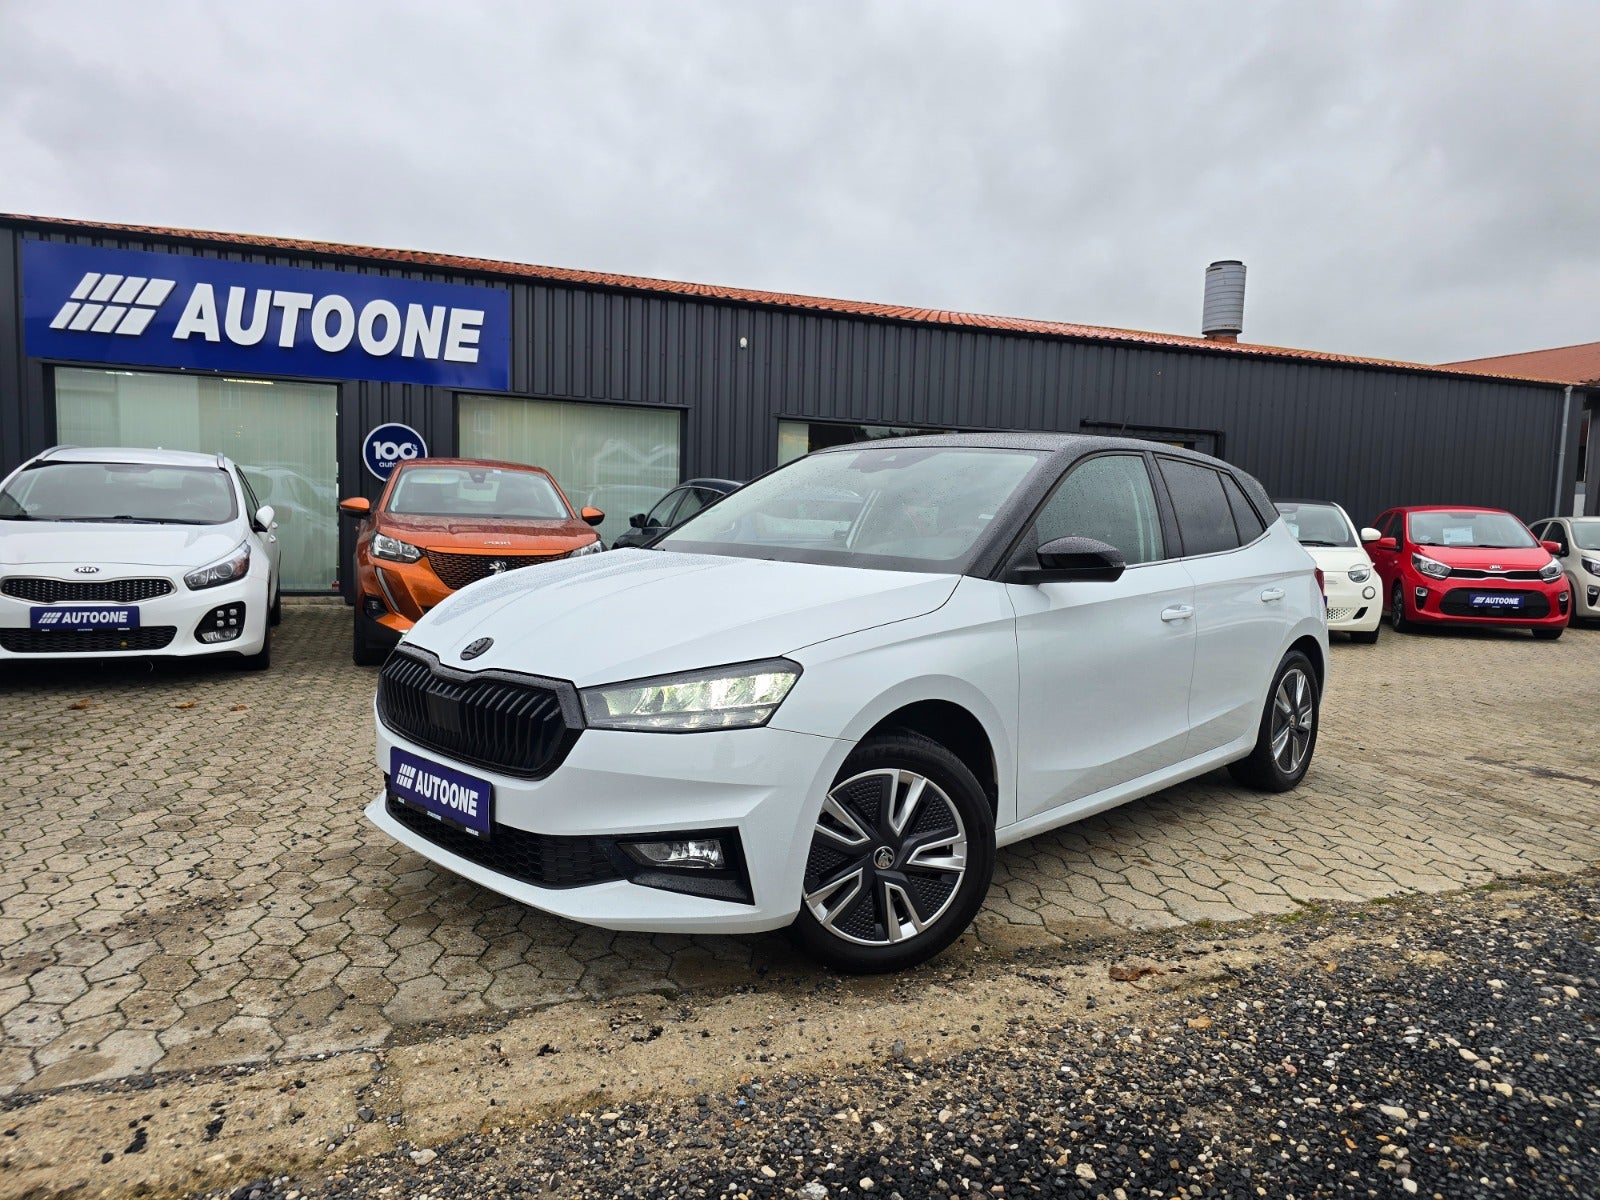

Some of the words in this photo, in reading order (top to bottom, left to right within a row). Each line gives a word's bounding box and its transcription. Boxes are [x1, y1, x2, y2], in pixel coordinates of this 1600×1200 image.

[172, 282, 485, 362] AUTOONE
[1485, 597, 1519, 605] AUTOONE
[61, 611, 128, 624] AUTOONE
[415, 770, 479, 817] AUTOONE
